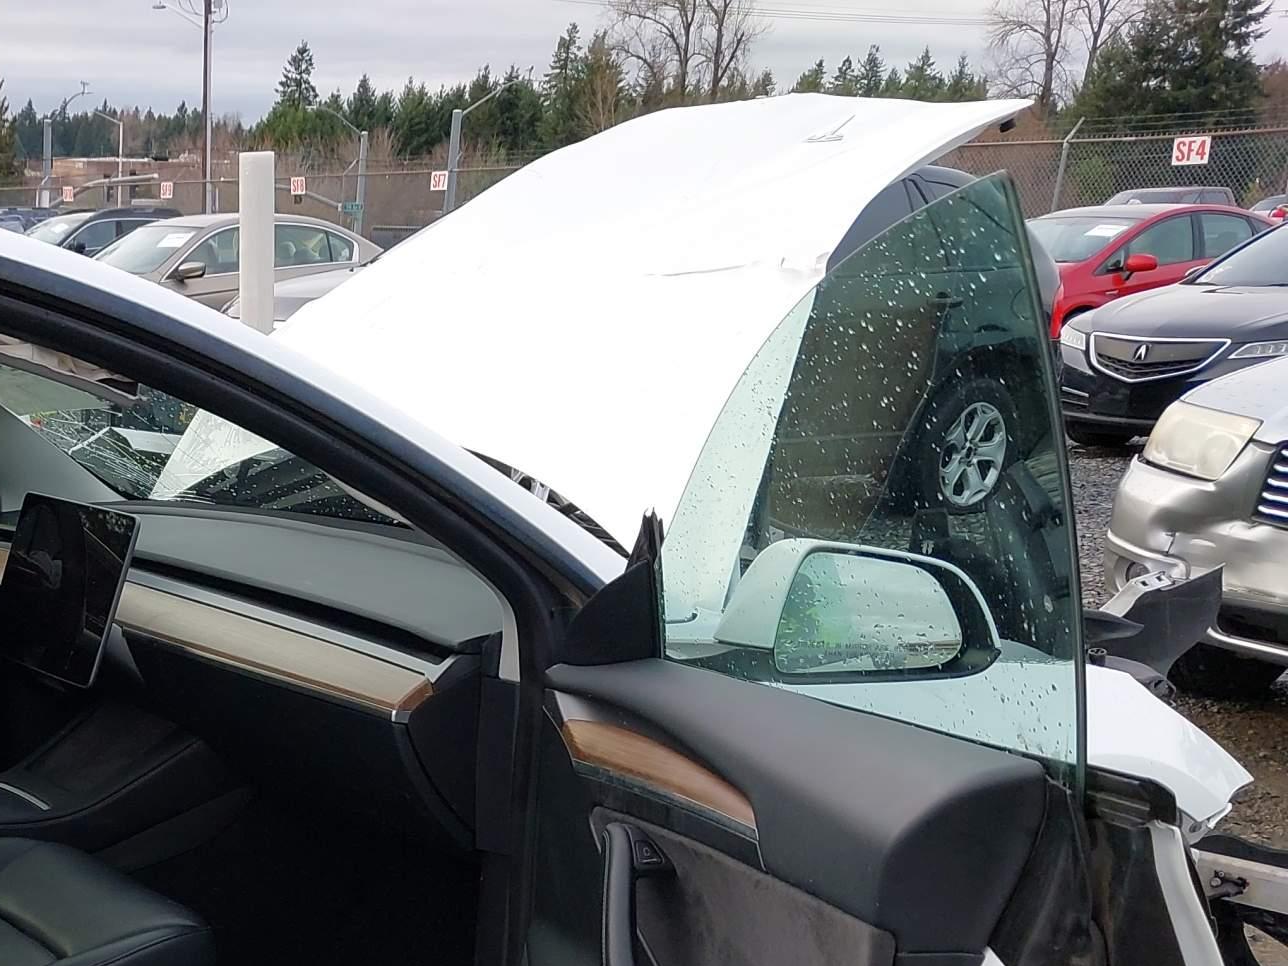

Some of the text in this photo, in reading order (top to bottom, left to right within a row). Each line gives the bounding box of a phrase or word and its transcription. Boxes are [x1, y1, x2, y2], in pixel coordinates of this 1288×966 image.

[1175, 140, 1207, 162] SF4
[292, 178, 305, 193] SF8
[433, 173, 447, 189] SF7
